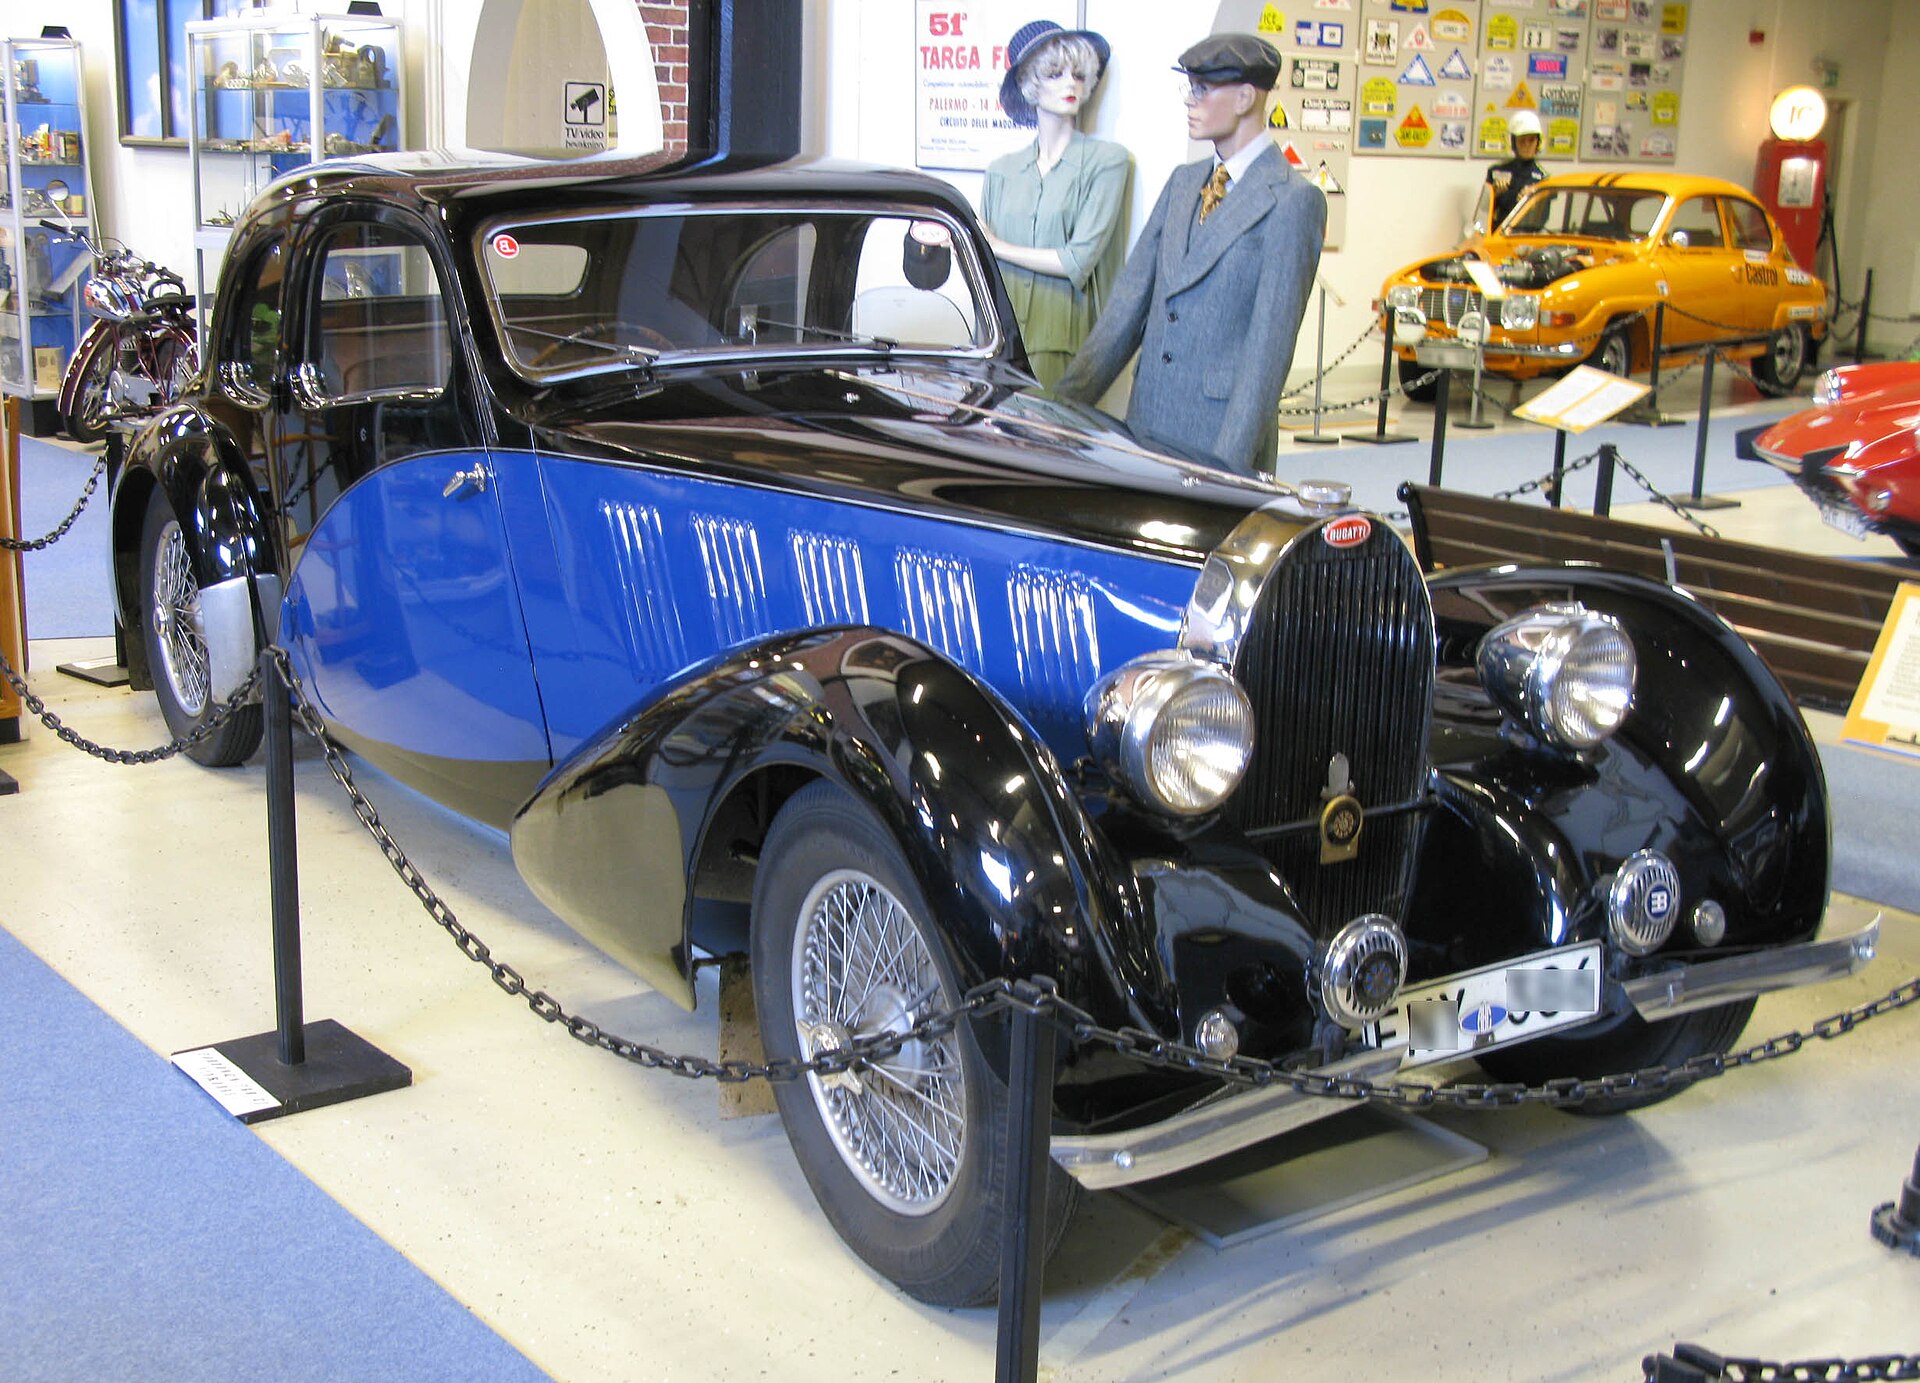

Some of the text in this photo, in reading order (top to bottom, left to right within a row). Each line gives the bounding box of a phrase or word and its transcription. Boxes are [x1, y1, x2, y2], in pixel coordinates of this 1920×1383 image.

[920, 45, 980, 70] TARGA
[929, 98, 968, 112] PALERMO
[980, 98, 988, 112] 14
[939, 116, 968, 128] CIRCUITO
[971, 117, 988, 129] DELLE
[565, 127, 604, 139] TV video
[1745, 262, 1778, 287] Castrol
[1329, 525, 1366, 542] BUGATTI
